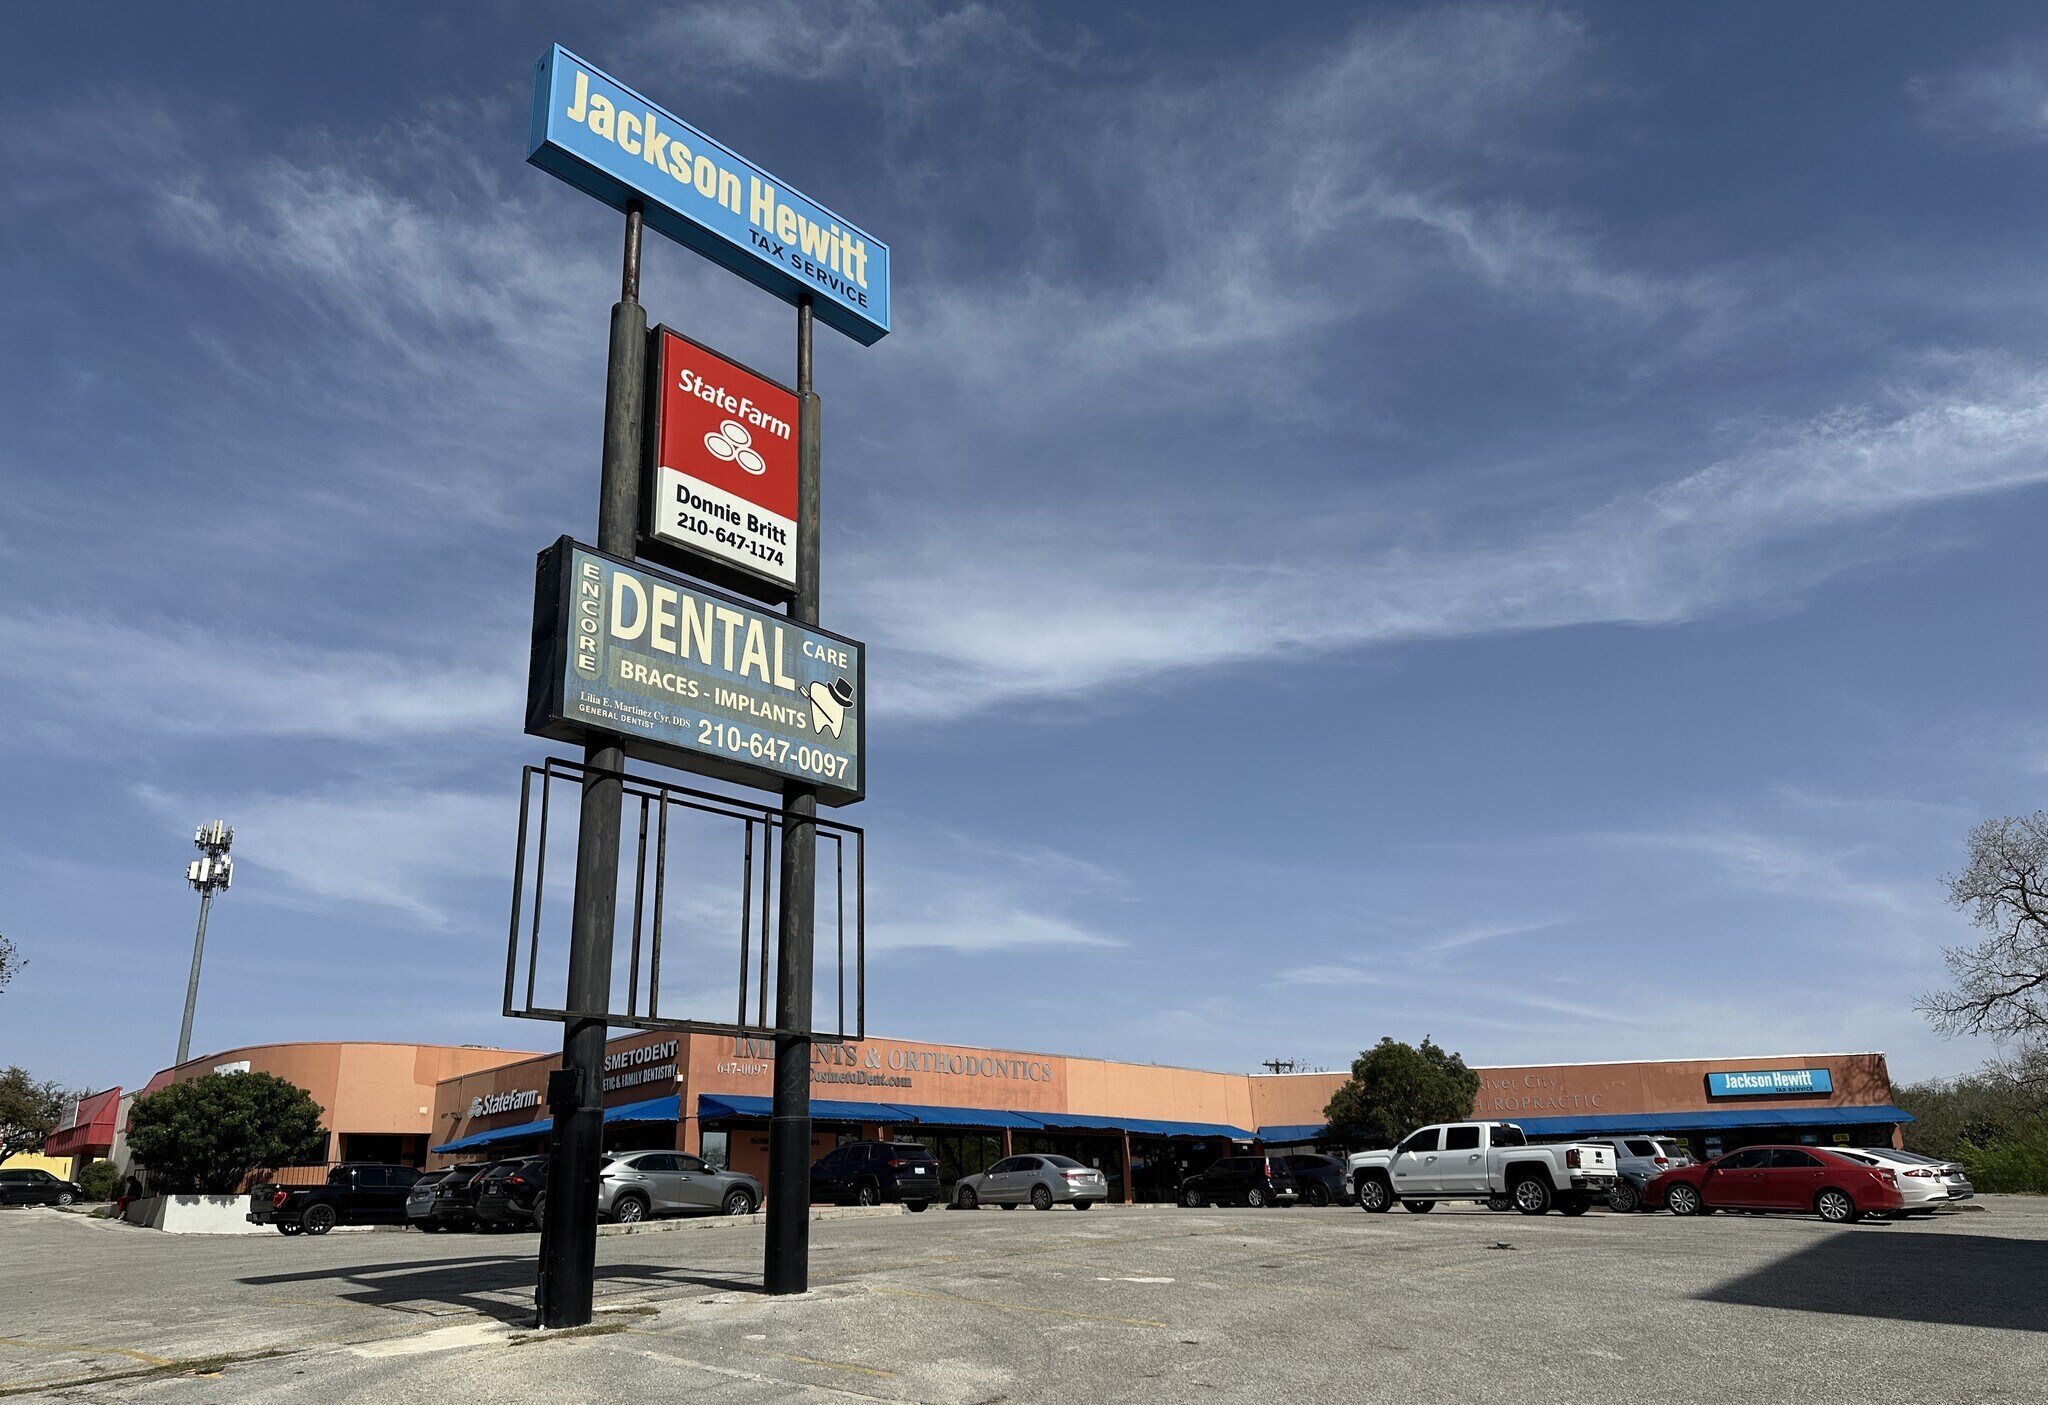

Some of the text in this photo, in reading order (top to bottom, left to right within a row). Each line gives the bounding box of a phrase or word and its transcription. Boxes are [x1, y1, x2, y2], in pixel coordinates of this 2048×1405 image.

[567, 70, 868, 290] Jackson Hewitt
[749, 228, 868, 309] TAX SERVICE
[676, 483, 788, 546] Donnie Britt
[677, 511, 784, 567] 210-647-1174
[578, 562, 601, 673] ENCORE
[610, 571, 849, 692] DENTAL CARE
[579, 703, 655, 730] GENERAL DENTIST
[580, 690, 691, 729] Lilia E. Martinez Cyr, DDS
[620, 659, 699, 698] BRACES
[714, 687, 807, 730] IMPLANTS
[698, 718, 849, 781] 210-647-0097
[604, 1040, 678, 1072] SMETODENT
[622, 1070, 643, 1088] FAMILY
[643, 1063, 677, 1083] DENTISTRY
[864, 1046, 882, 1069] &
[887, 1049, 1053, 1083] ORTHODONTICS
[1473, 1093, 1604, 1113] HIROPRACTIC
[1524, 1074, 1557, 1091] City
[1725, 1071, 1813, 1089] Jackson Hewitt
